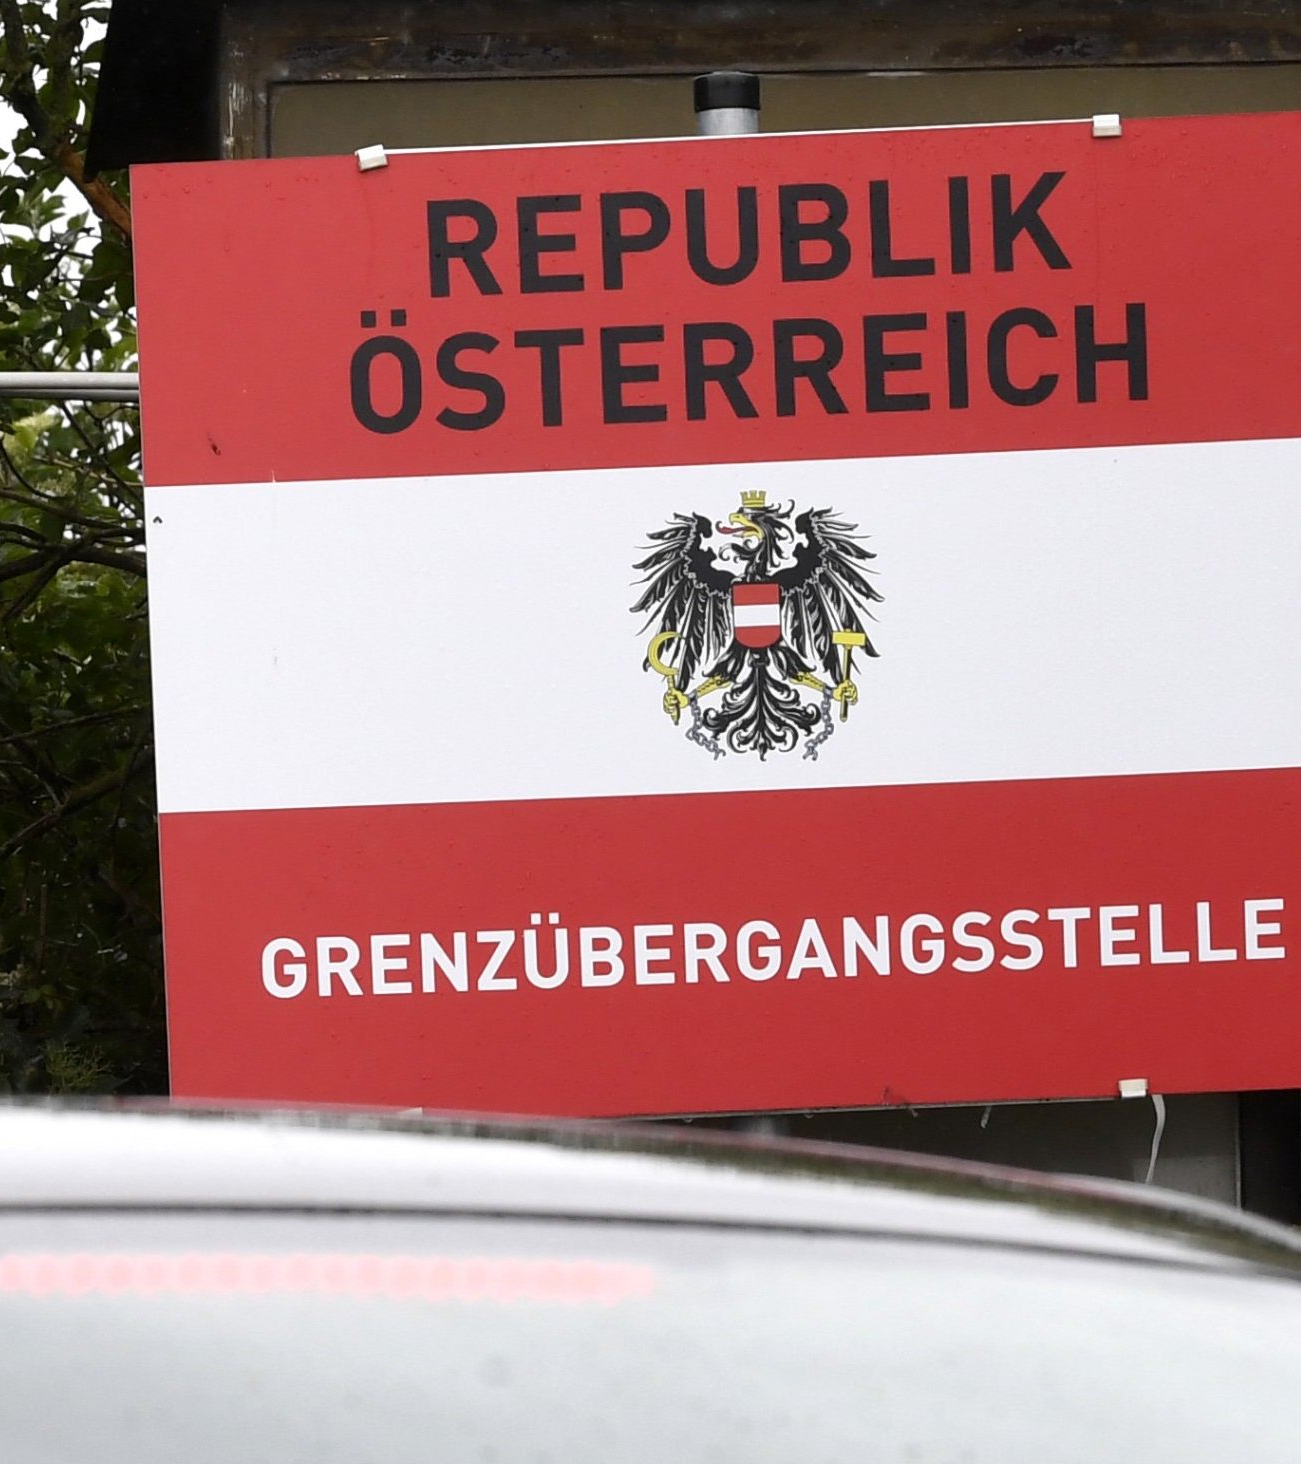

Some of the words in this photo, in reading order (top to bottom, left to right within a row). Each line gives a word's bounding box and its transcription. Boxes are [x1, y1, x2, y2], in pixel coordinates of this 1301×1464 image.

[426, 170, 1073, 299] REPUBLIK
[349, 301, 1150, 436] ÖSTERREICH
[260, 897, 1287, 1000] GRENZÜBERGANGSSTELLE
